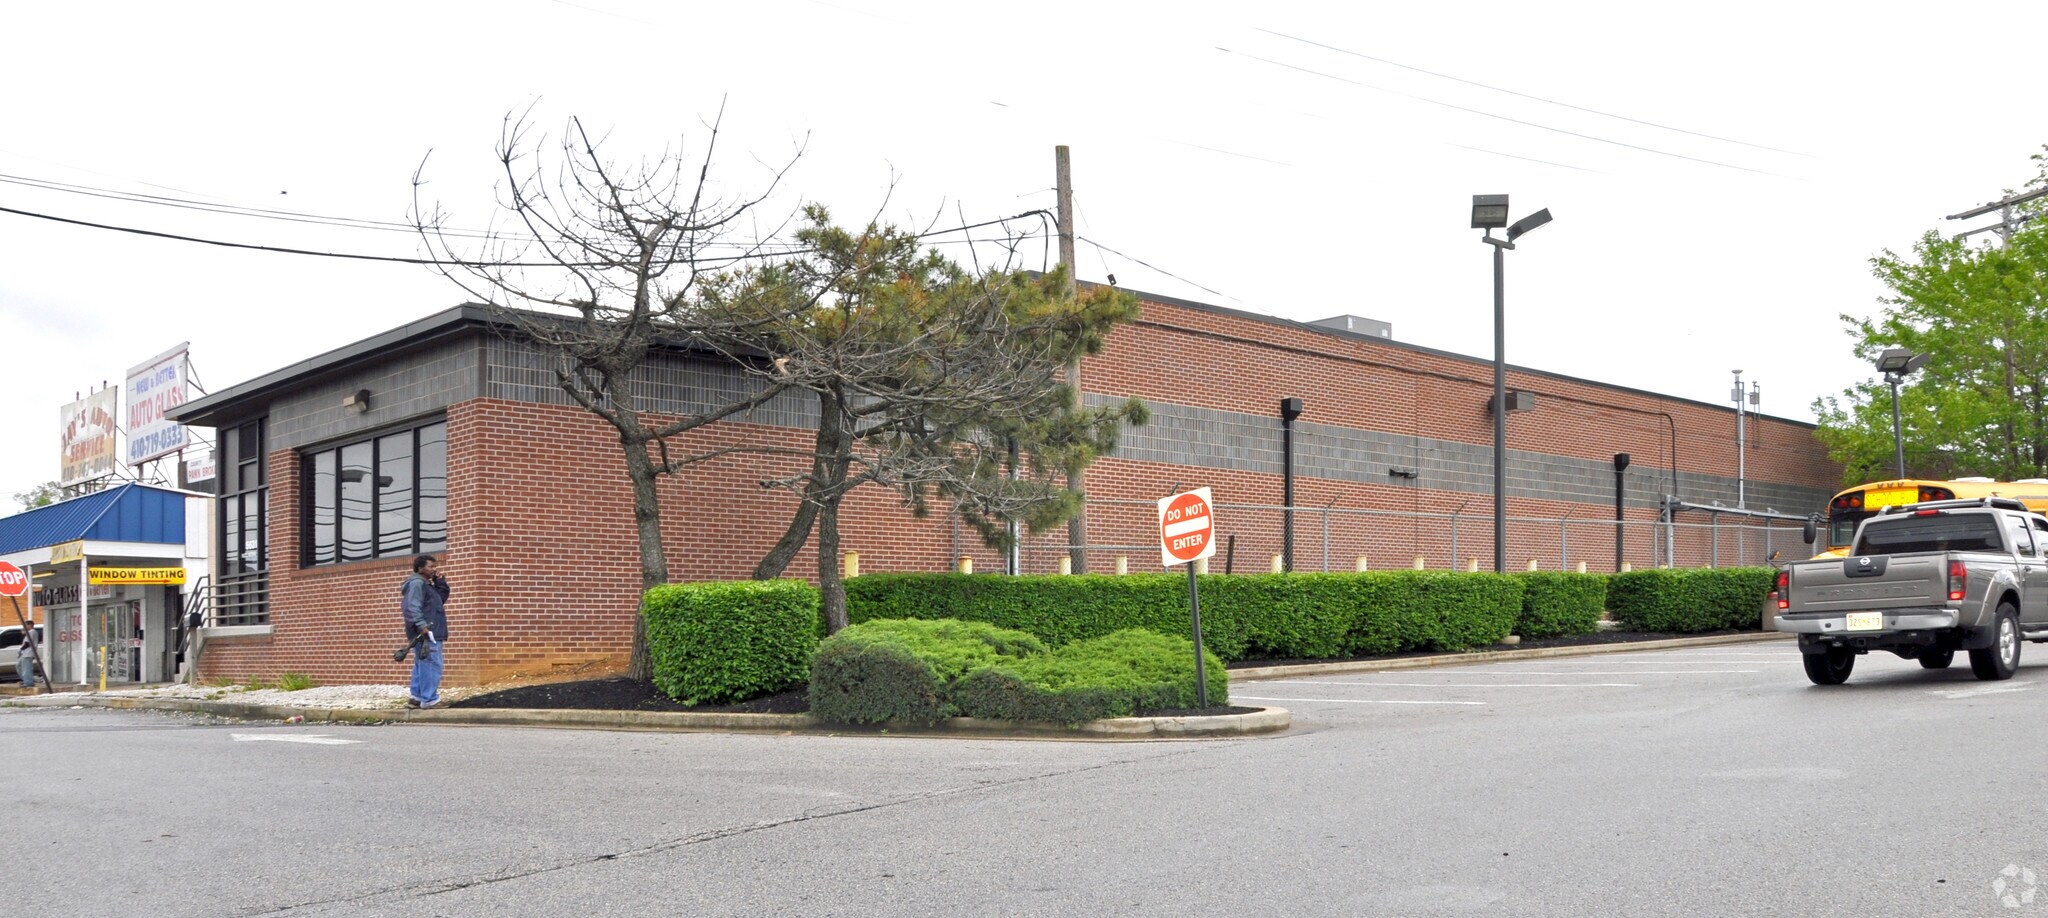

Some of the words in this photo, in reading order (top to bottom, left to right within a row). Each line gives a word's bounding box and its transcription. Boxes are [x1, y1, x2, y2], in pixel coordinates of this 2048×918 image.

[135, 377, 149, 395] NEW
[130, 398, 153, 430] AUTO
[155, 386, 184, 419] GLASS
[90, 406, 113, 436] AUTO
[70, 434, 105, 463] SERVICE
[130, 425, 183, 460] 410-719-0333
[1865, 491, 1897, 506] SCHOOL
[1899, 490, 1918, 504] BUS
[1167, 508, 1181, 522] DO
[1185, 503, 1203, 517] NOT
[1173, 534, 1203, 550] ENTER
[0, 571, 23, 585] TOP
[89, 570, 137, 579] WINDOW
[141, 570, 184, 579] TINTING
